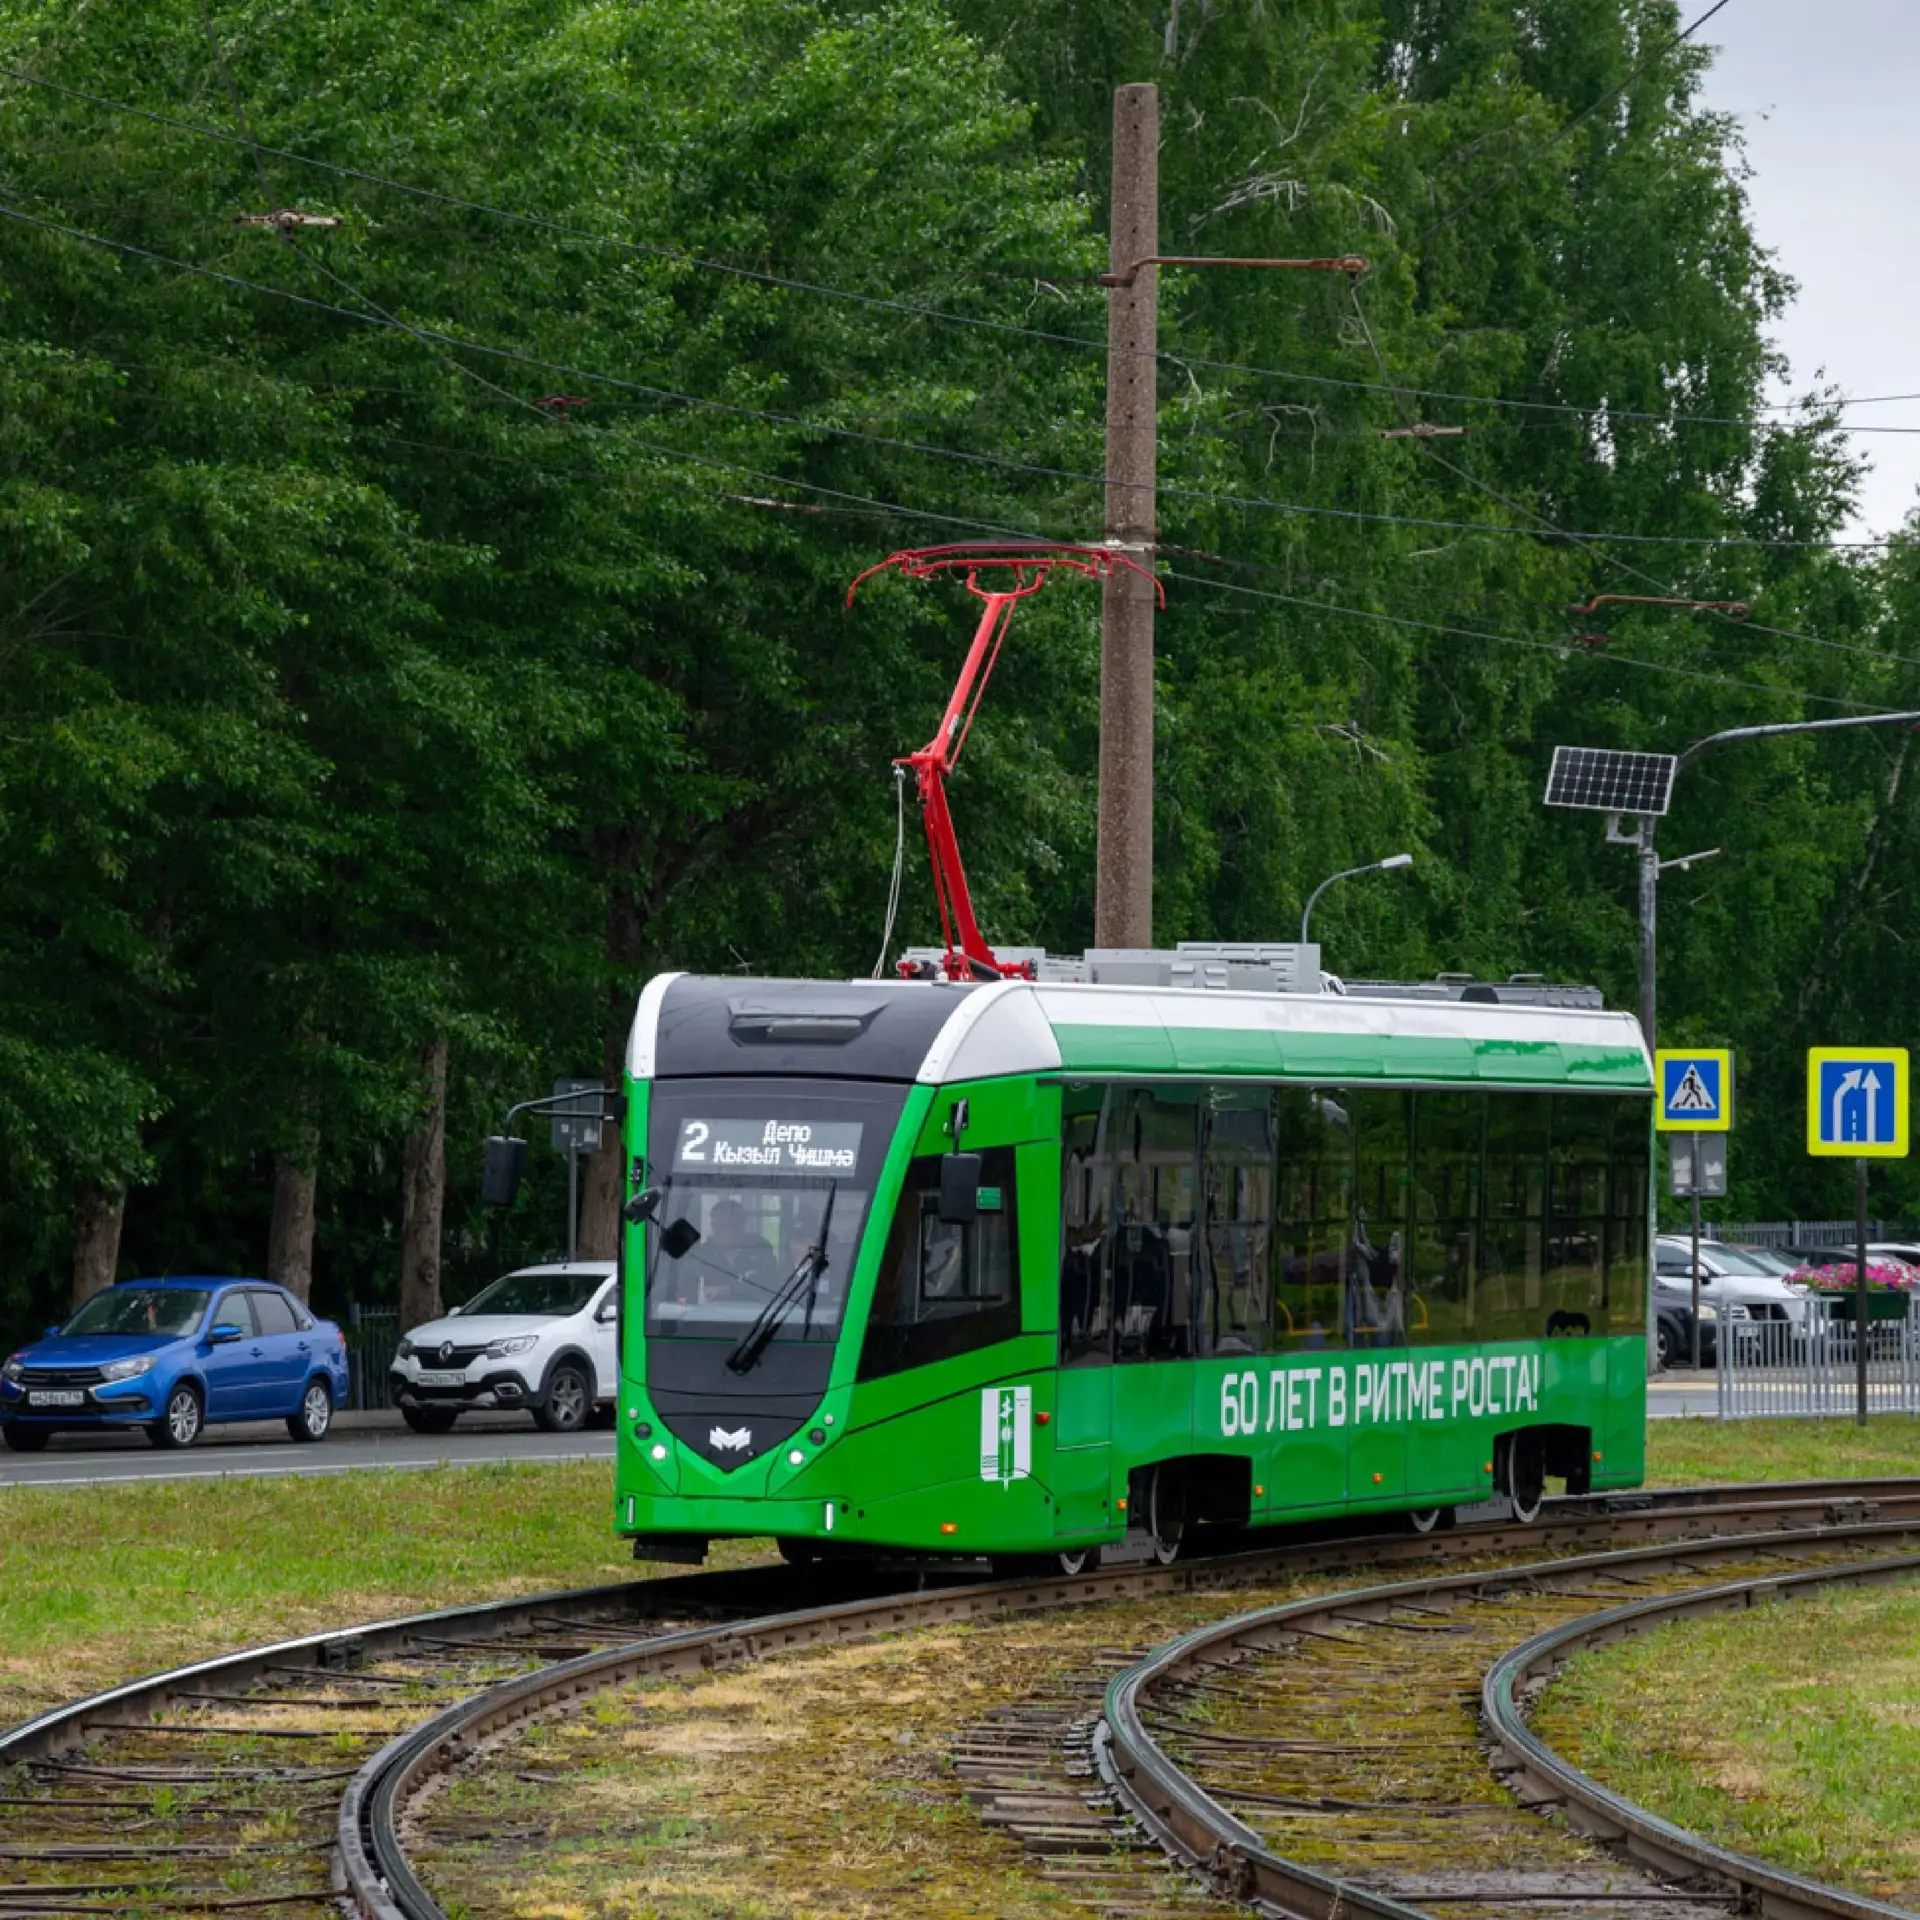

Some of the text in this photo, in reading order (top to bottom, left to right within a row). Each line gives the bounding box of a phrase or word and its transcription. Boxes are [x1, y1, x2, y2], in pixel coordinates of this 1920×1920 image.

[681, 1121, 709, 1161] 2
[762, 1120, 812, 1145] Депо
[714, 1141, 781, 1165] Кызыл
[1220, 1354, 1538, 1436] 60 ЛЕТ В РИТМЕ РОСТА!
